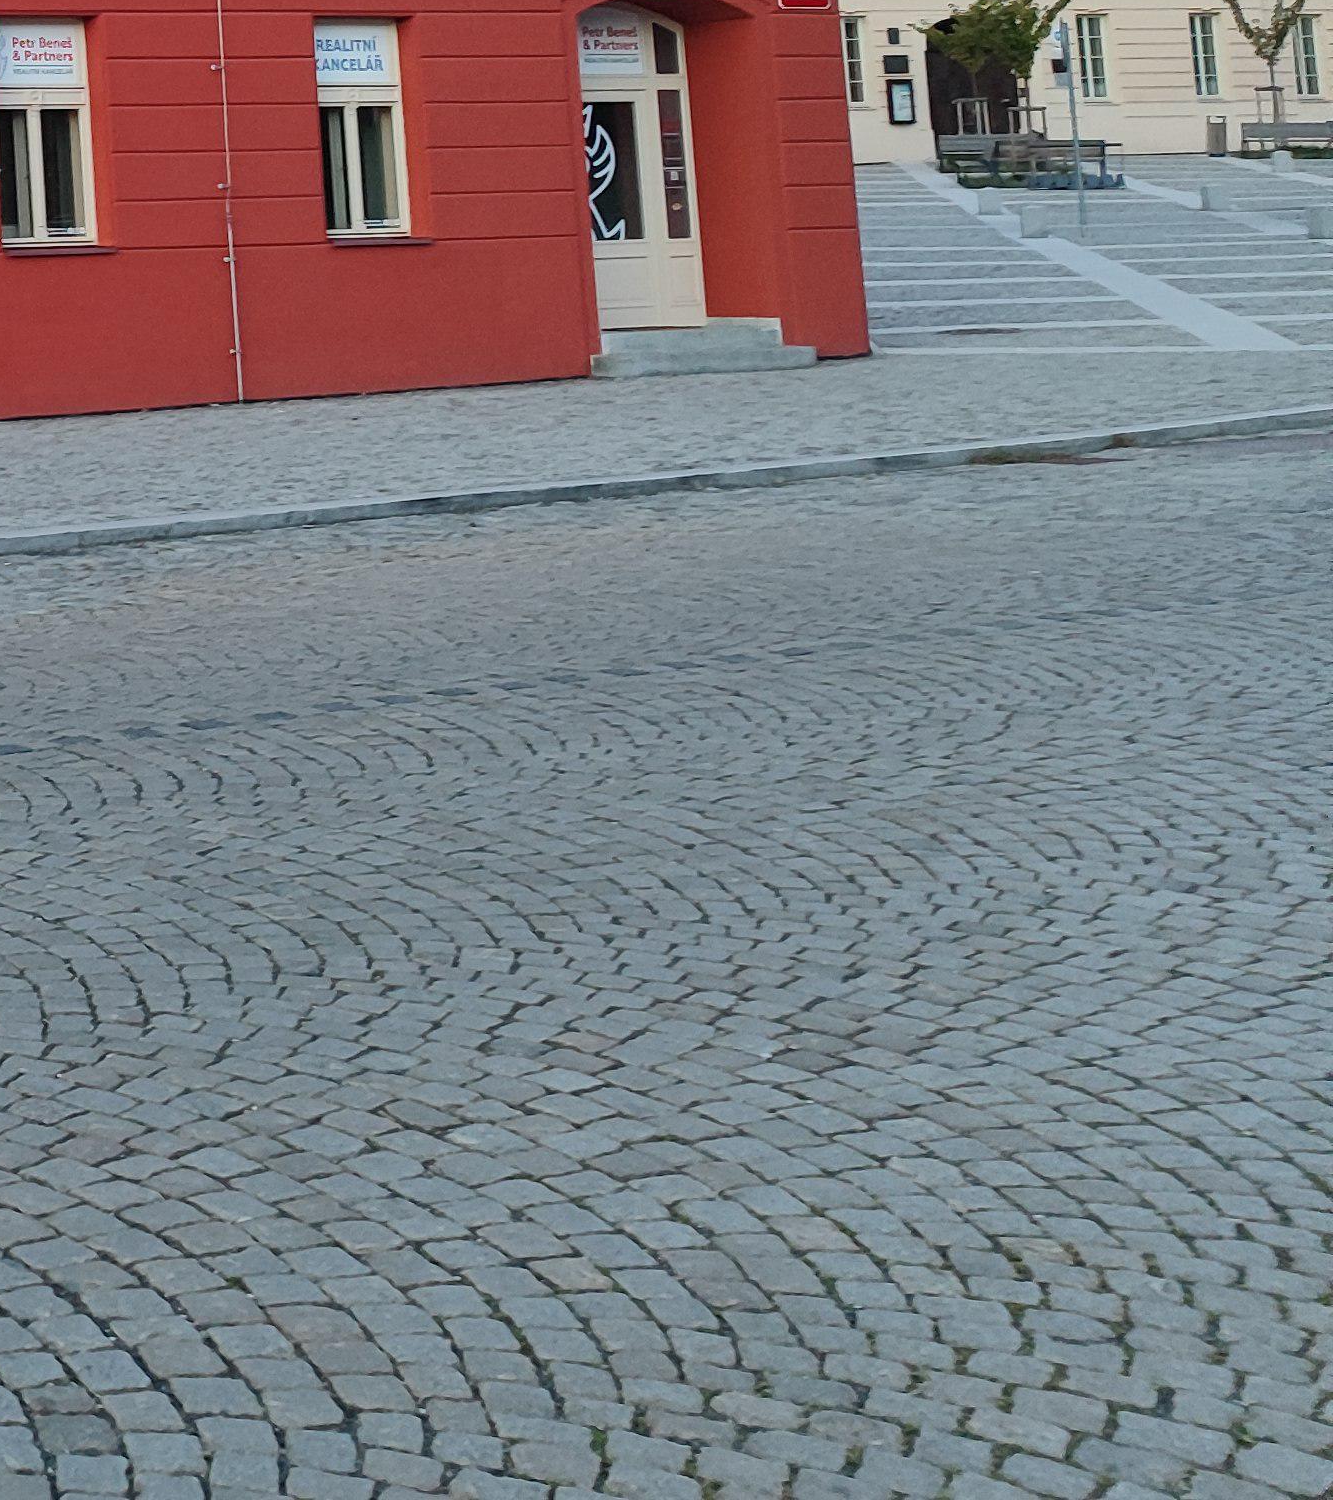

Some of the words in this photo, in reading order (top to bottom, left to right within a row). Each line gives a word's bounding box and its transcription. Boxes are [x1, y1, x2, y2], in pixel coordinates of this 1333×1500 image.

[12, 37, 35, 48] Petr
[316, 36, 376, 51] REALITNÍ
[12, 51, 21, 61] &
[24, 50, 73, 61] Partners
